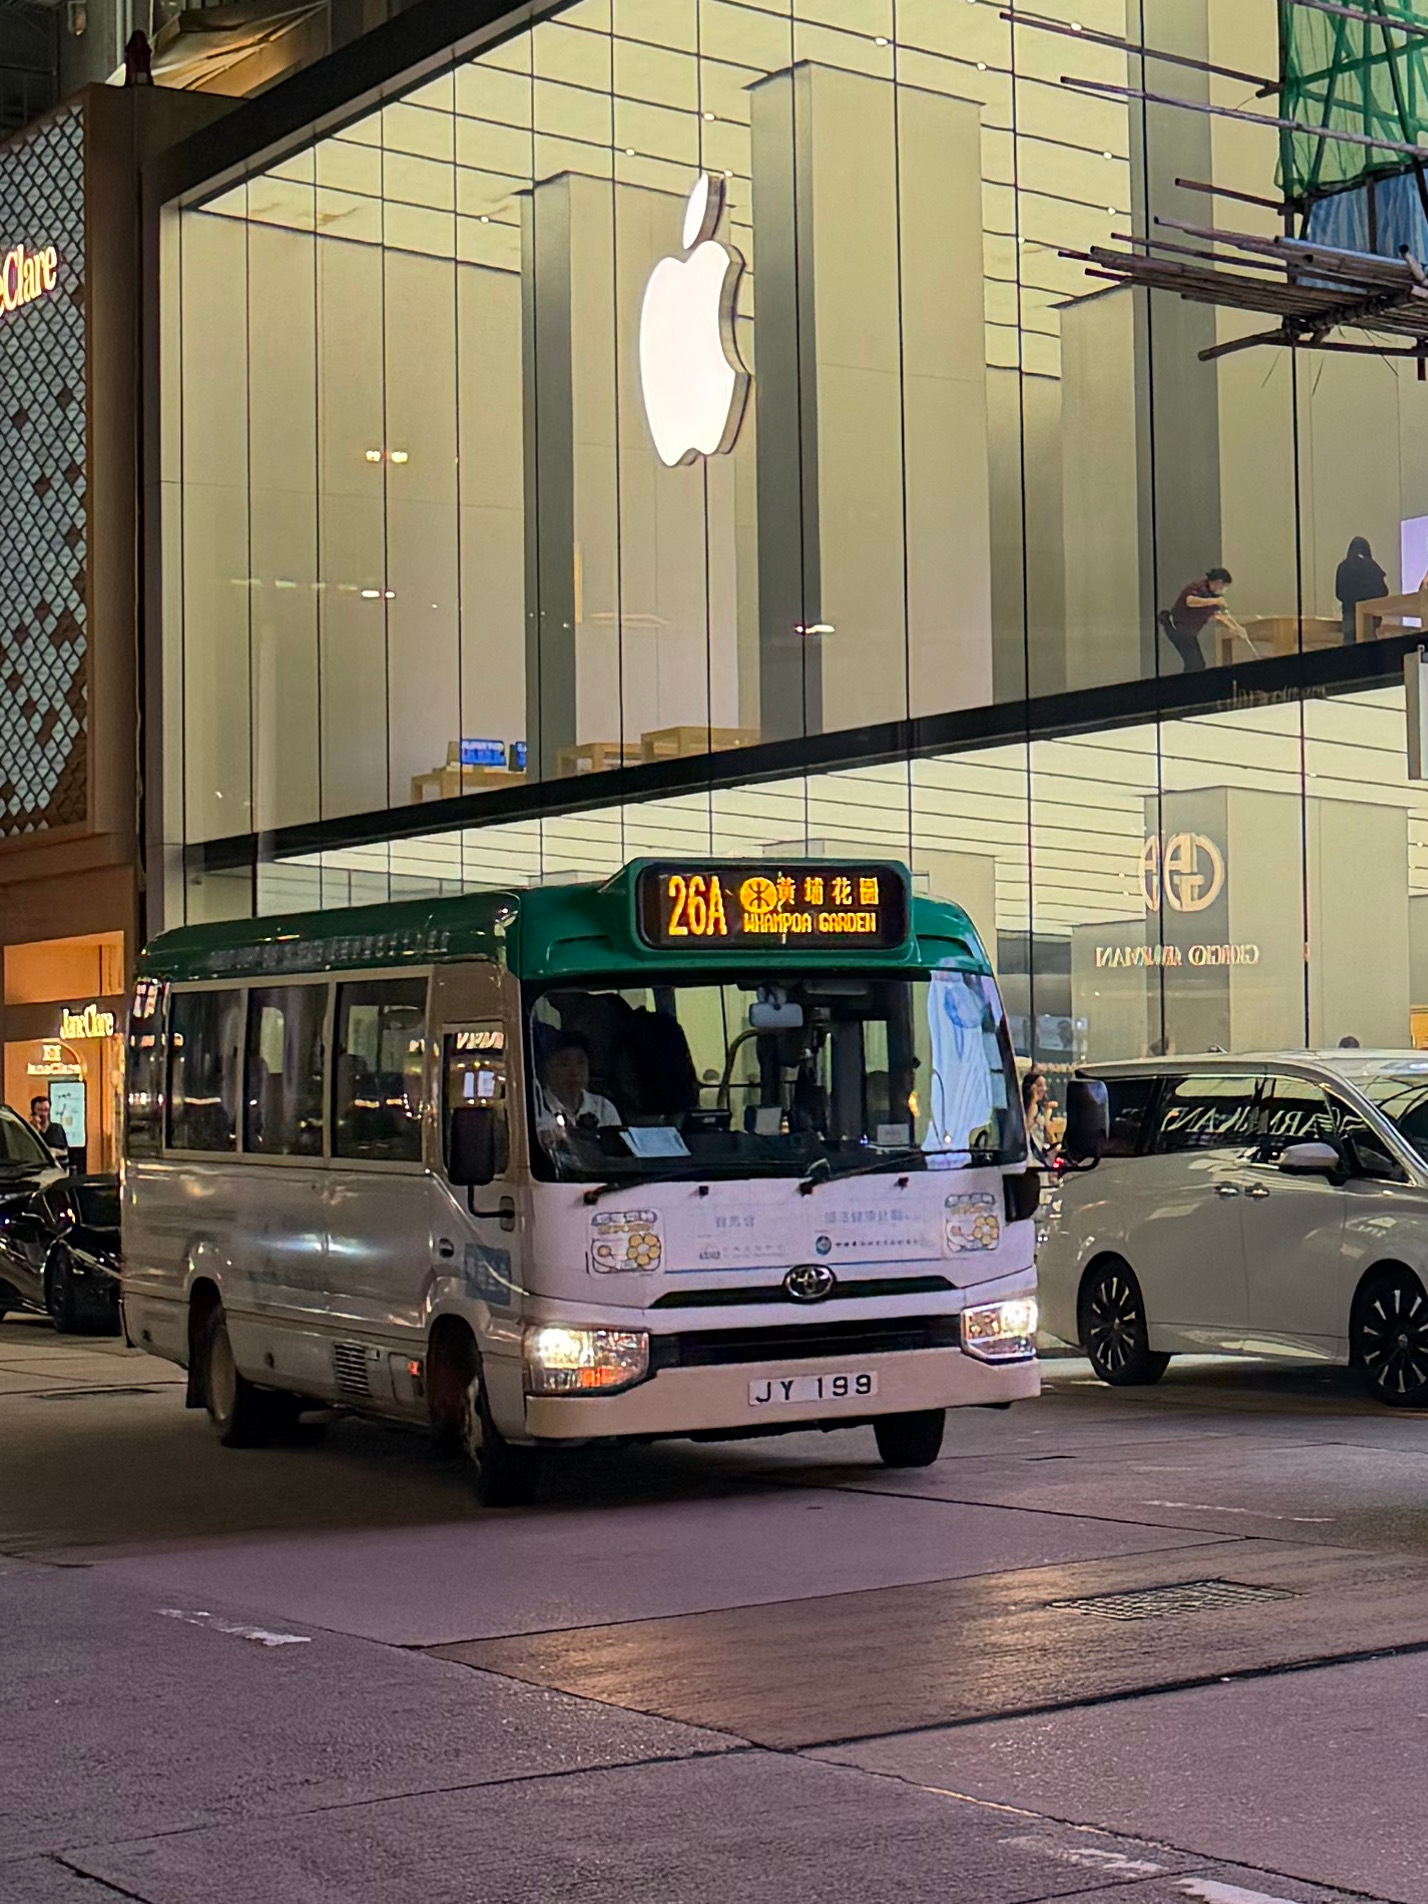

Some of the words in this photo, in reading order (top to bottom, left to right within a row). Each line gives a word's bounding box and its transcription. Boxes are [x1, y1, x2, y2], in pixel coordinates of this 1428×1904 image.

[669, 876, 728, 936] 26A
[743, 912, 812, 934] WHAMPOA
[819, 912, 876, 933] GARDEN
[755, 1379, 795, 1404] JY
[815, 1374, 873, 1397] 199
